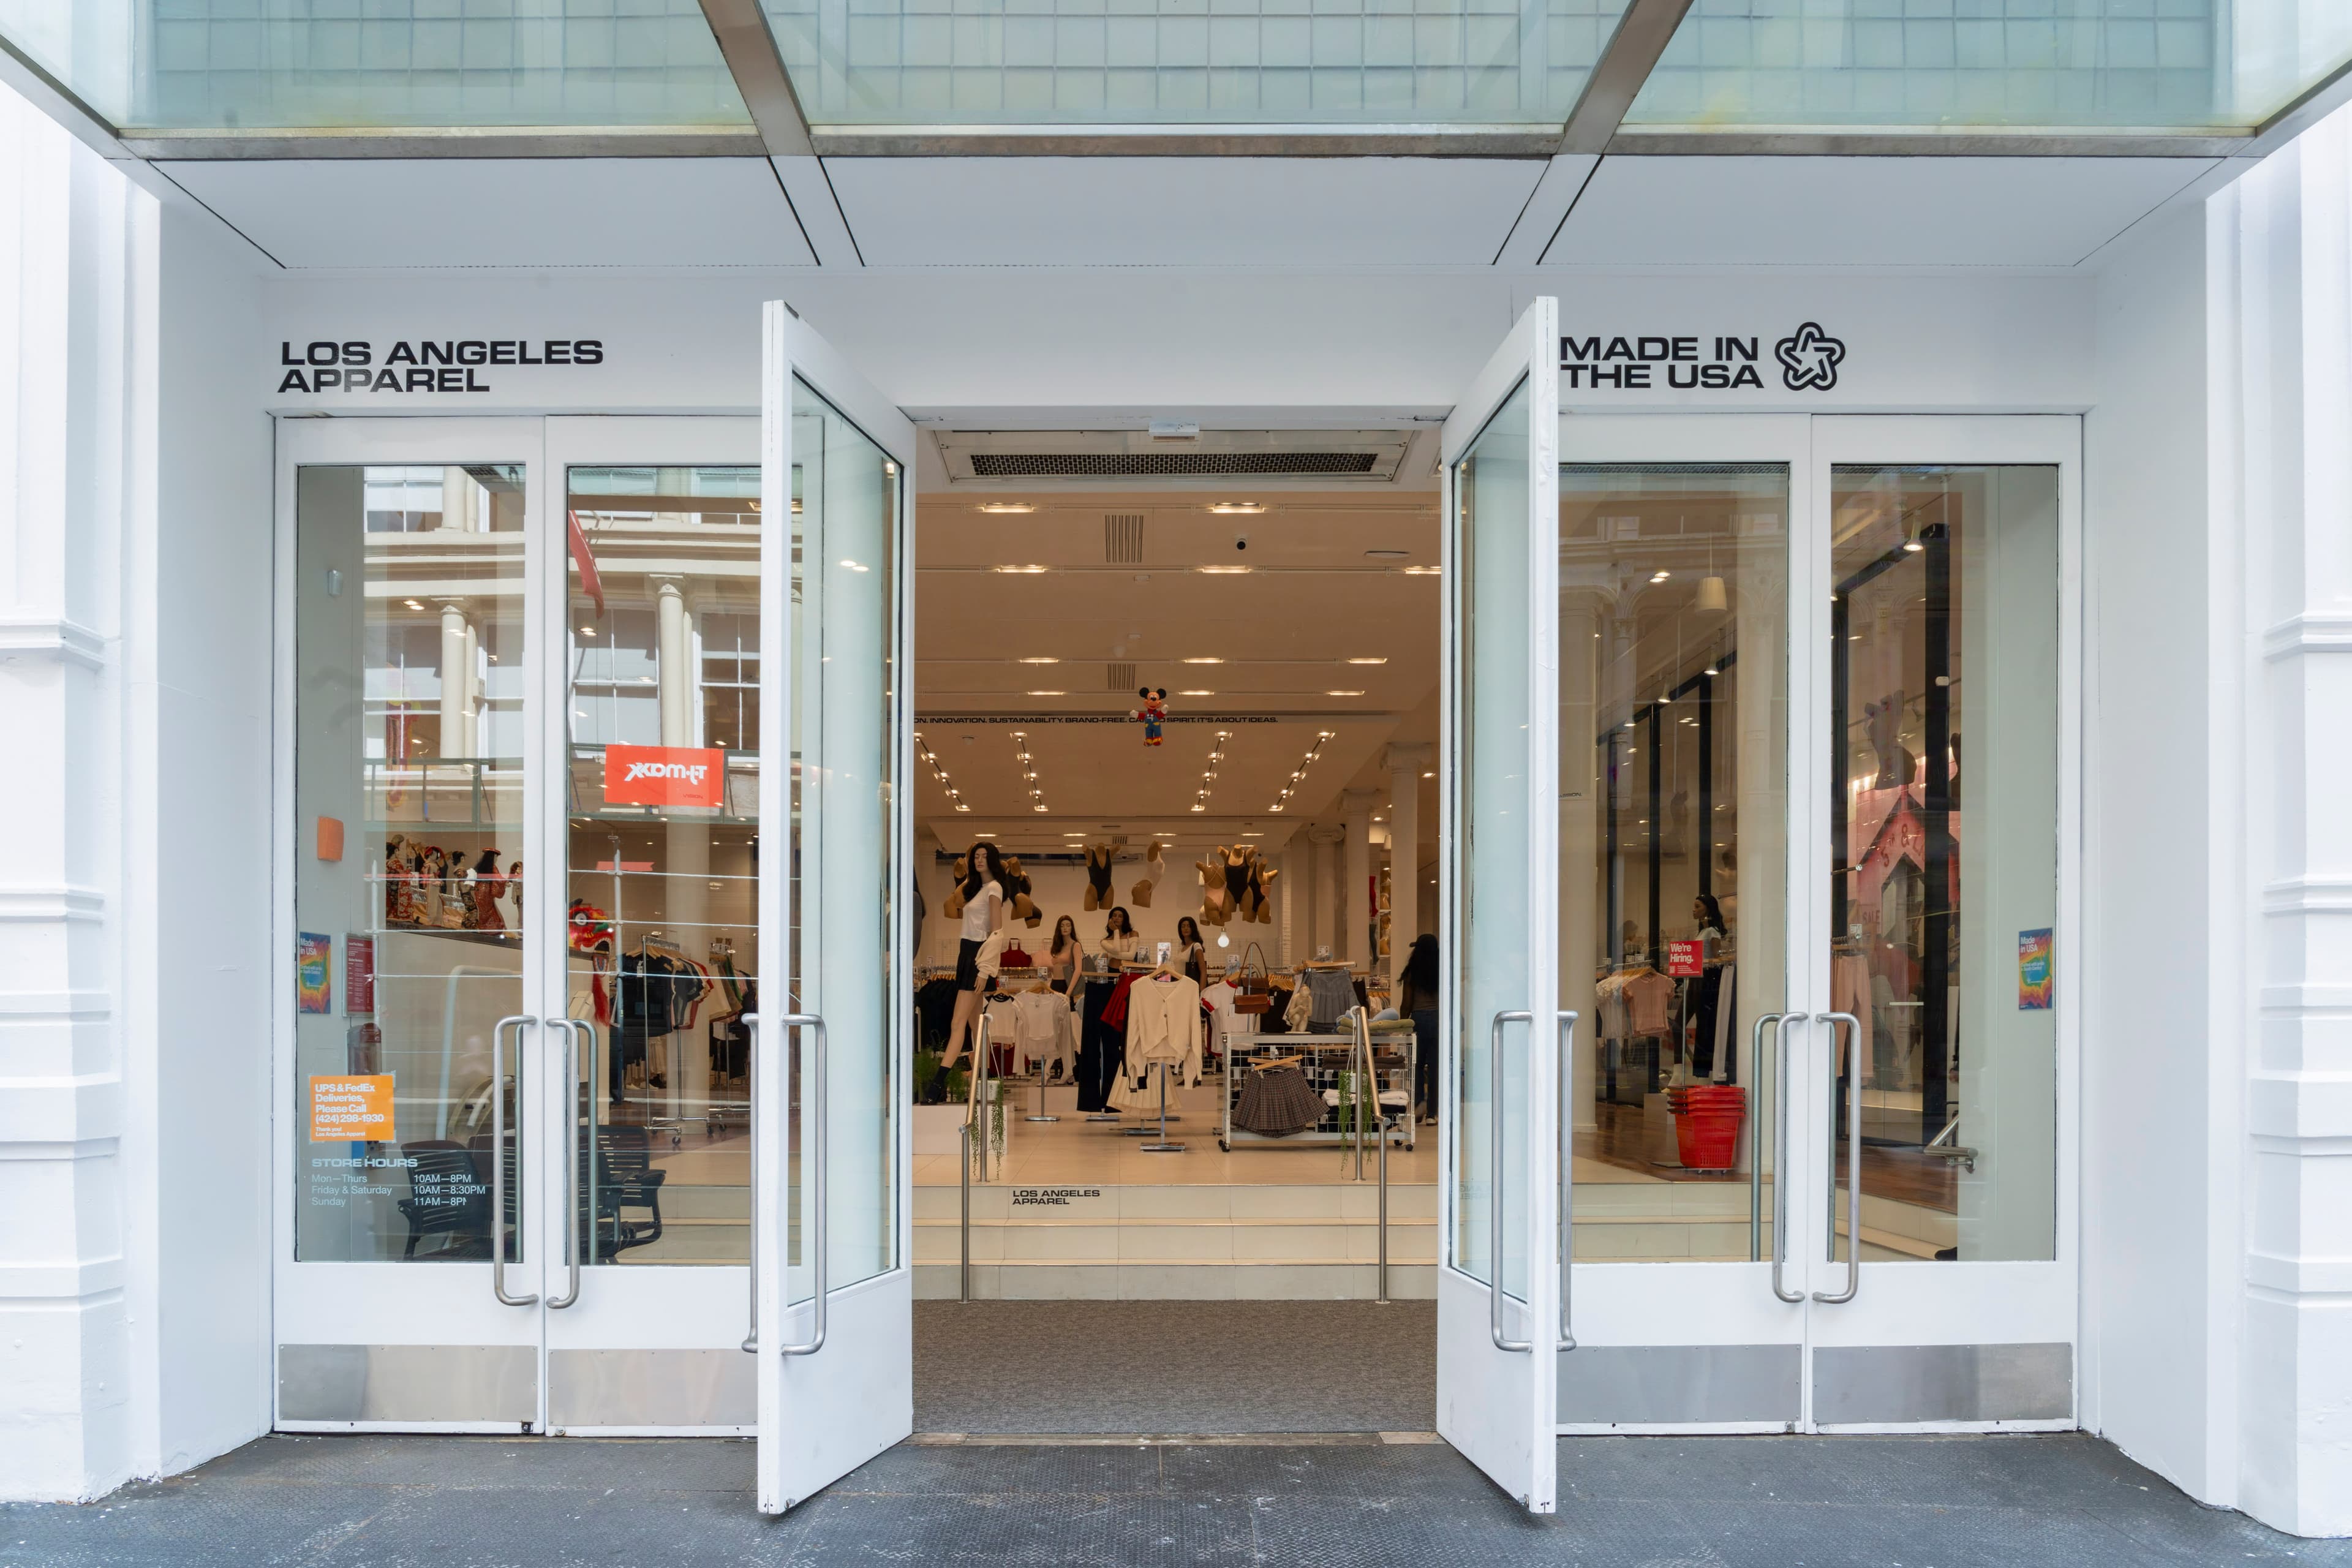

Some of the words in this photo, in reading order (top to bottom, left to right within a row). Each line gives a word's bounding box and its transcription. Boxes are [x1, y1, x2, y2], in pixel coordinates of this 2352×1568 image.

[281, 341, 371, 366] LOS
[385, 340, 604, 365] ANGELES
[1560, 337, 1698, 361] MADE
[1716, 337, 1758, 361] IN
[277, 368, 491, 393] APPAREL
[1560, 364, 1651, 388] THE
[1668, 364, 1764, 389] USA
[301, 938, 314, 947] Made
[2021, 936, 2035, 944] Made
[1670, 943, 1692, 952] We're
[2026, 943, 2038, 952] USA
[1670, 953, 1694, 964] Hiring.
[315, 1084, 336, 1092] UPS
[337, 1084, 344, 1092] &
[345, 1083, 375, 1092] FedEx
[315, 1093, 365, 1102] Deliveries,
[315, 1104, 348, 1113] Please
[348, 1104, 367, 1113] Call
[315, 1114, 339, 1125] (424)
[340, 1114, 385, 1123] 298-1930
[312, 1158, 361, 1167] STORE
[366, 1158, 418, 1167] HOURS
[312, 1186, 339, 1196] Friday
[342, 1186, 349, 1194] &
[351, 1186, 393, 1196] Saturday
[312, 1197, 346, 1207] Sunday
